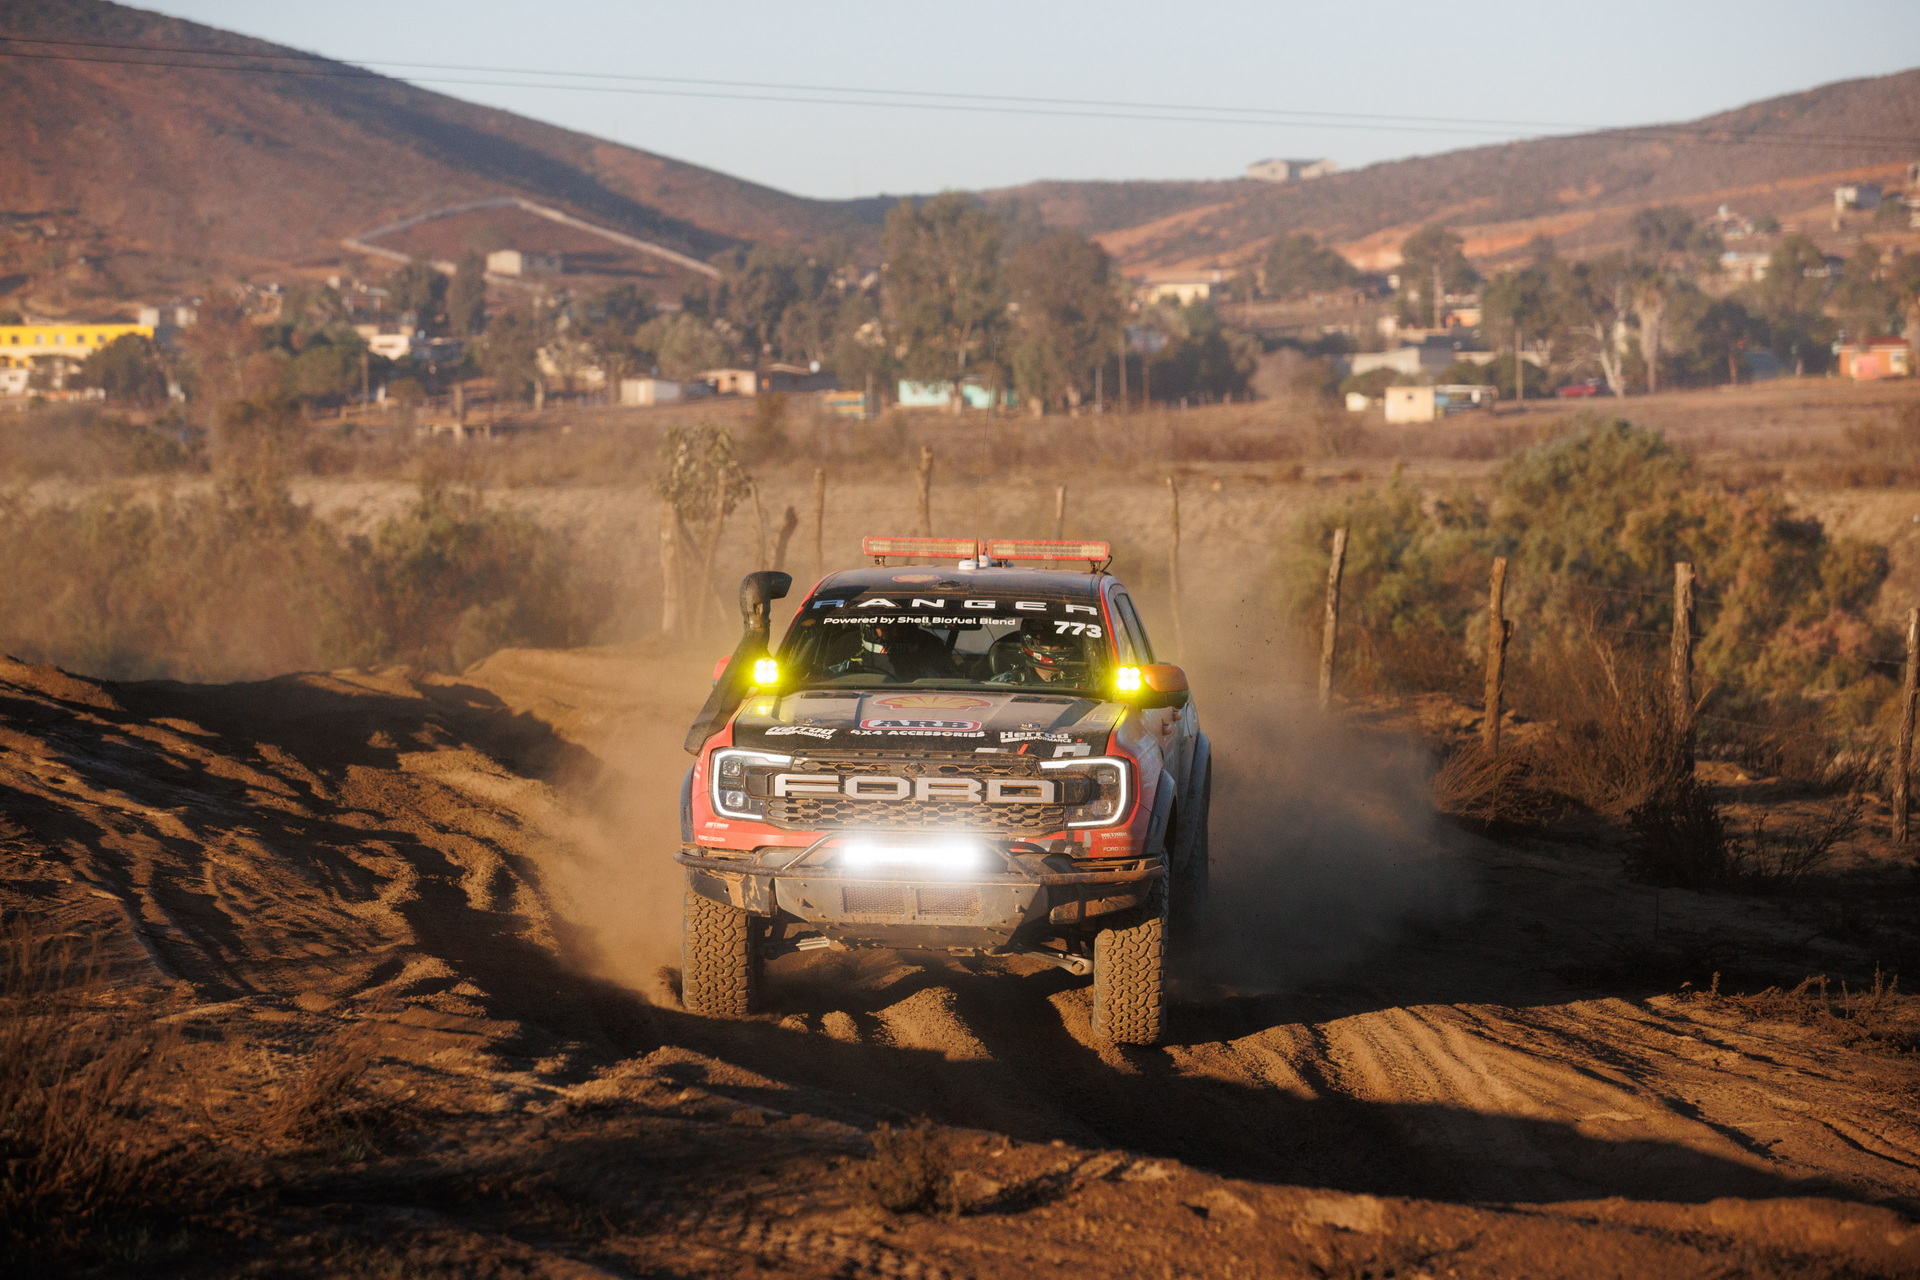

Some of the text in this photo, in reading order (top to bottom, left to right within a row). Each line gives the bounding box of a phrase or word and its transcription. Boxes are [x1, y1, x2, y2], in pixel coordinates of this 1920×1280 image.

[812, 598, 1098, 616] RANGER
[823, 616, 1016, 626] Powered by Shell Biofuel Blend
[1053, 620, 1103, 638] 773
[874, 720, 969, 729] ARB
[887, 730, 986, 738] ACCESSORIES
[1000, 731, 1069, 739] Herrod
[1019, 735, 1072, 744] PERFORMANCE
[774, 773, 1055, 804] FORD
